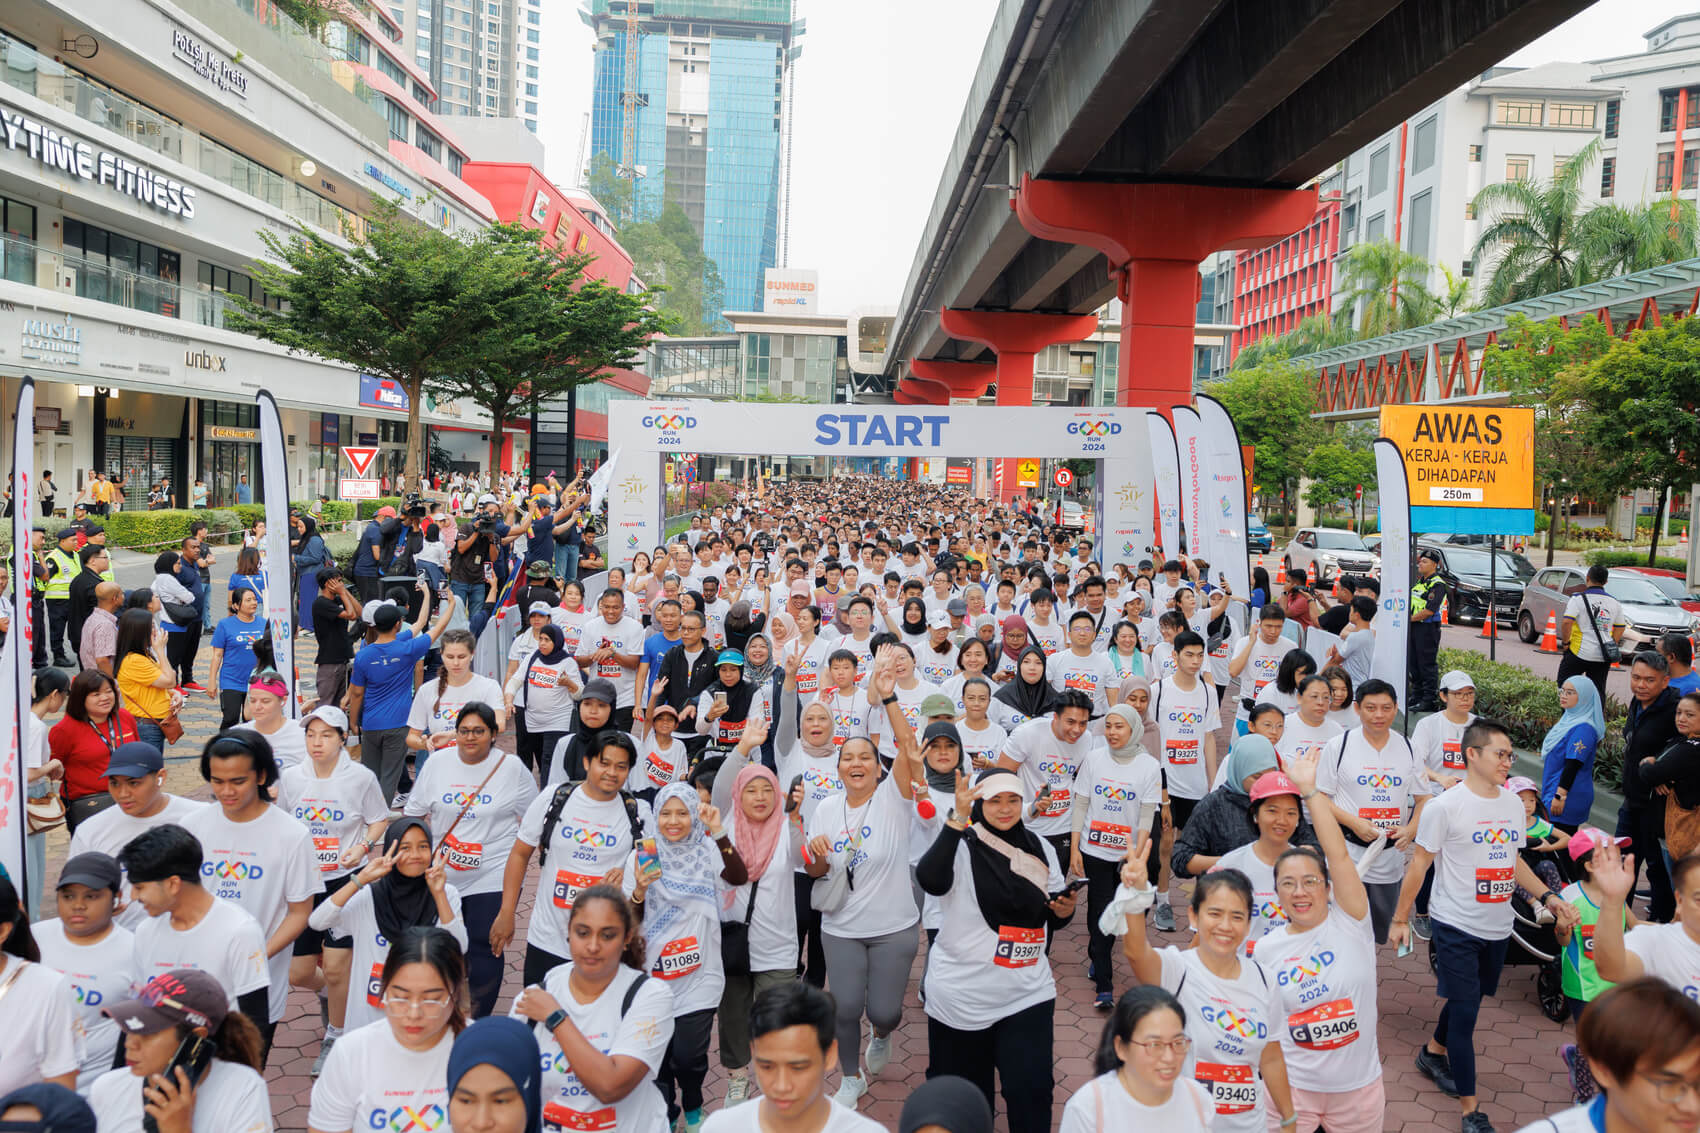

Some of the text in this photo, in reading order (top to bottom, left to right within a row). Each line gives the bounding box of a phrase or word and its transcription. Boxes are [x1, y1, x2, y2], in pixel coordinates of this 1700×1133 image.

[207, 51, 219, 72] Me
[0, 108, 196, 219] YTIME FITNESS
[814, 413, 950, 447] START
[1413, 412, 1502, 445] AWAS
[657, 437, 681, 445] 2024
[1082, 443, 1106, 451] 2024
[1405, 448, 1450, 463] KERJA
[1463, 450, 1508, 465] KERJA
[1417, 467, 1496, 483] DIHADAPAN
[1443, 489, 1472, 500] 250m
[1445, 752, 1454, 761] G
[1371, 794, 1391, 802] 2024
[1103, 803, 1122, 812] 2024
[1089, 831, 1099, 841] G
[450, 851, 481, 867] 92226
[572, 850, 598, 862] 2024
[1488, 852, 1507, 860] 2024
[555, 884, 565, 897] G
[1478, 882, 1488, 893] G
[998, 943, 1010, 956] G
[664, 952, 700, 969] 91089
[369, 980, 381, 994] G
[1300, 978, 1318, 990] RUN
[1298, 983, 1329, 1004] 2024
[1292, 1018, 1358, 1041] G 93406
[1225, 1032, 1243, 1044] RUN
[1215, 1040, 1245, 1056] 2024
[1216, 1086, 1257, 1102] 93403
